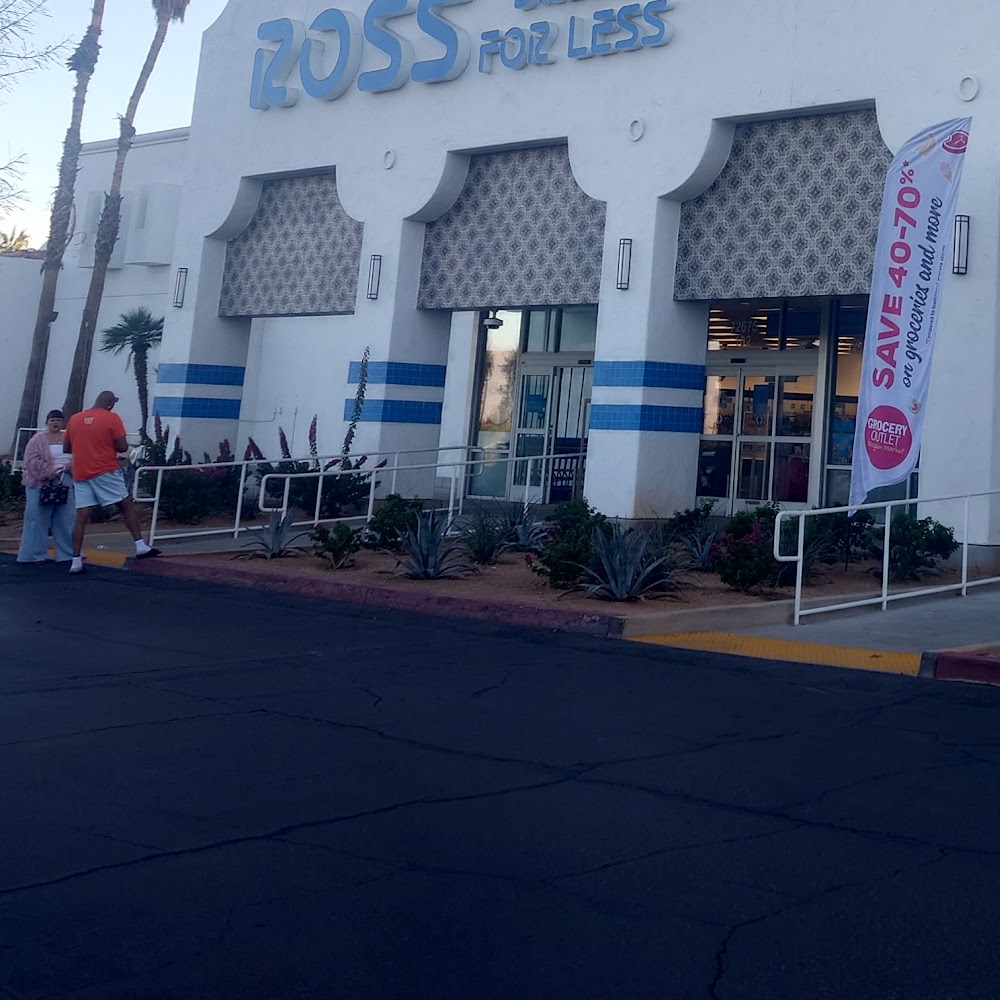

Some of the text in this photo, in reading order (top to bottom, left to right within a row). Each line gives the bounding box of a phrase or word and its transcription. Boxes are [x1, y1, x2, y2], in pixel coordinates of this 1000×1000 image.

[479, 21, 558, 74] FOR
[902, 196, 943, 388] on groceries and more
[872, 293, 903, 390] SAVE
[867, 417, 908, 436] GROCERY
[870, 429, 901, 446] OUTLET
